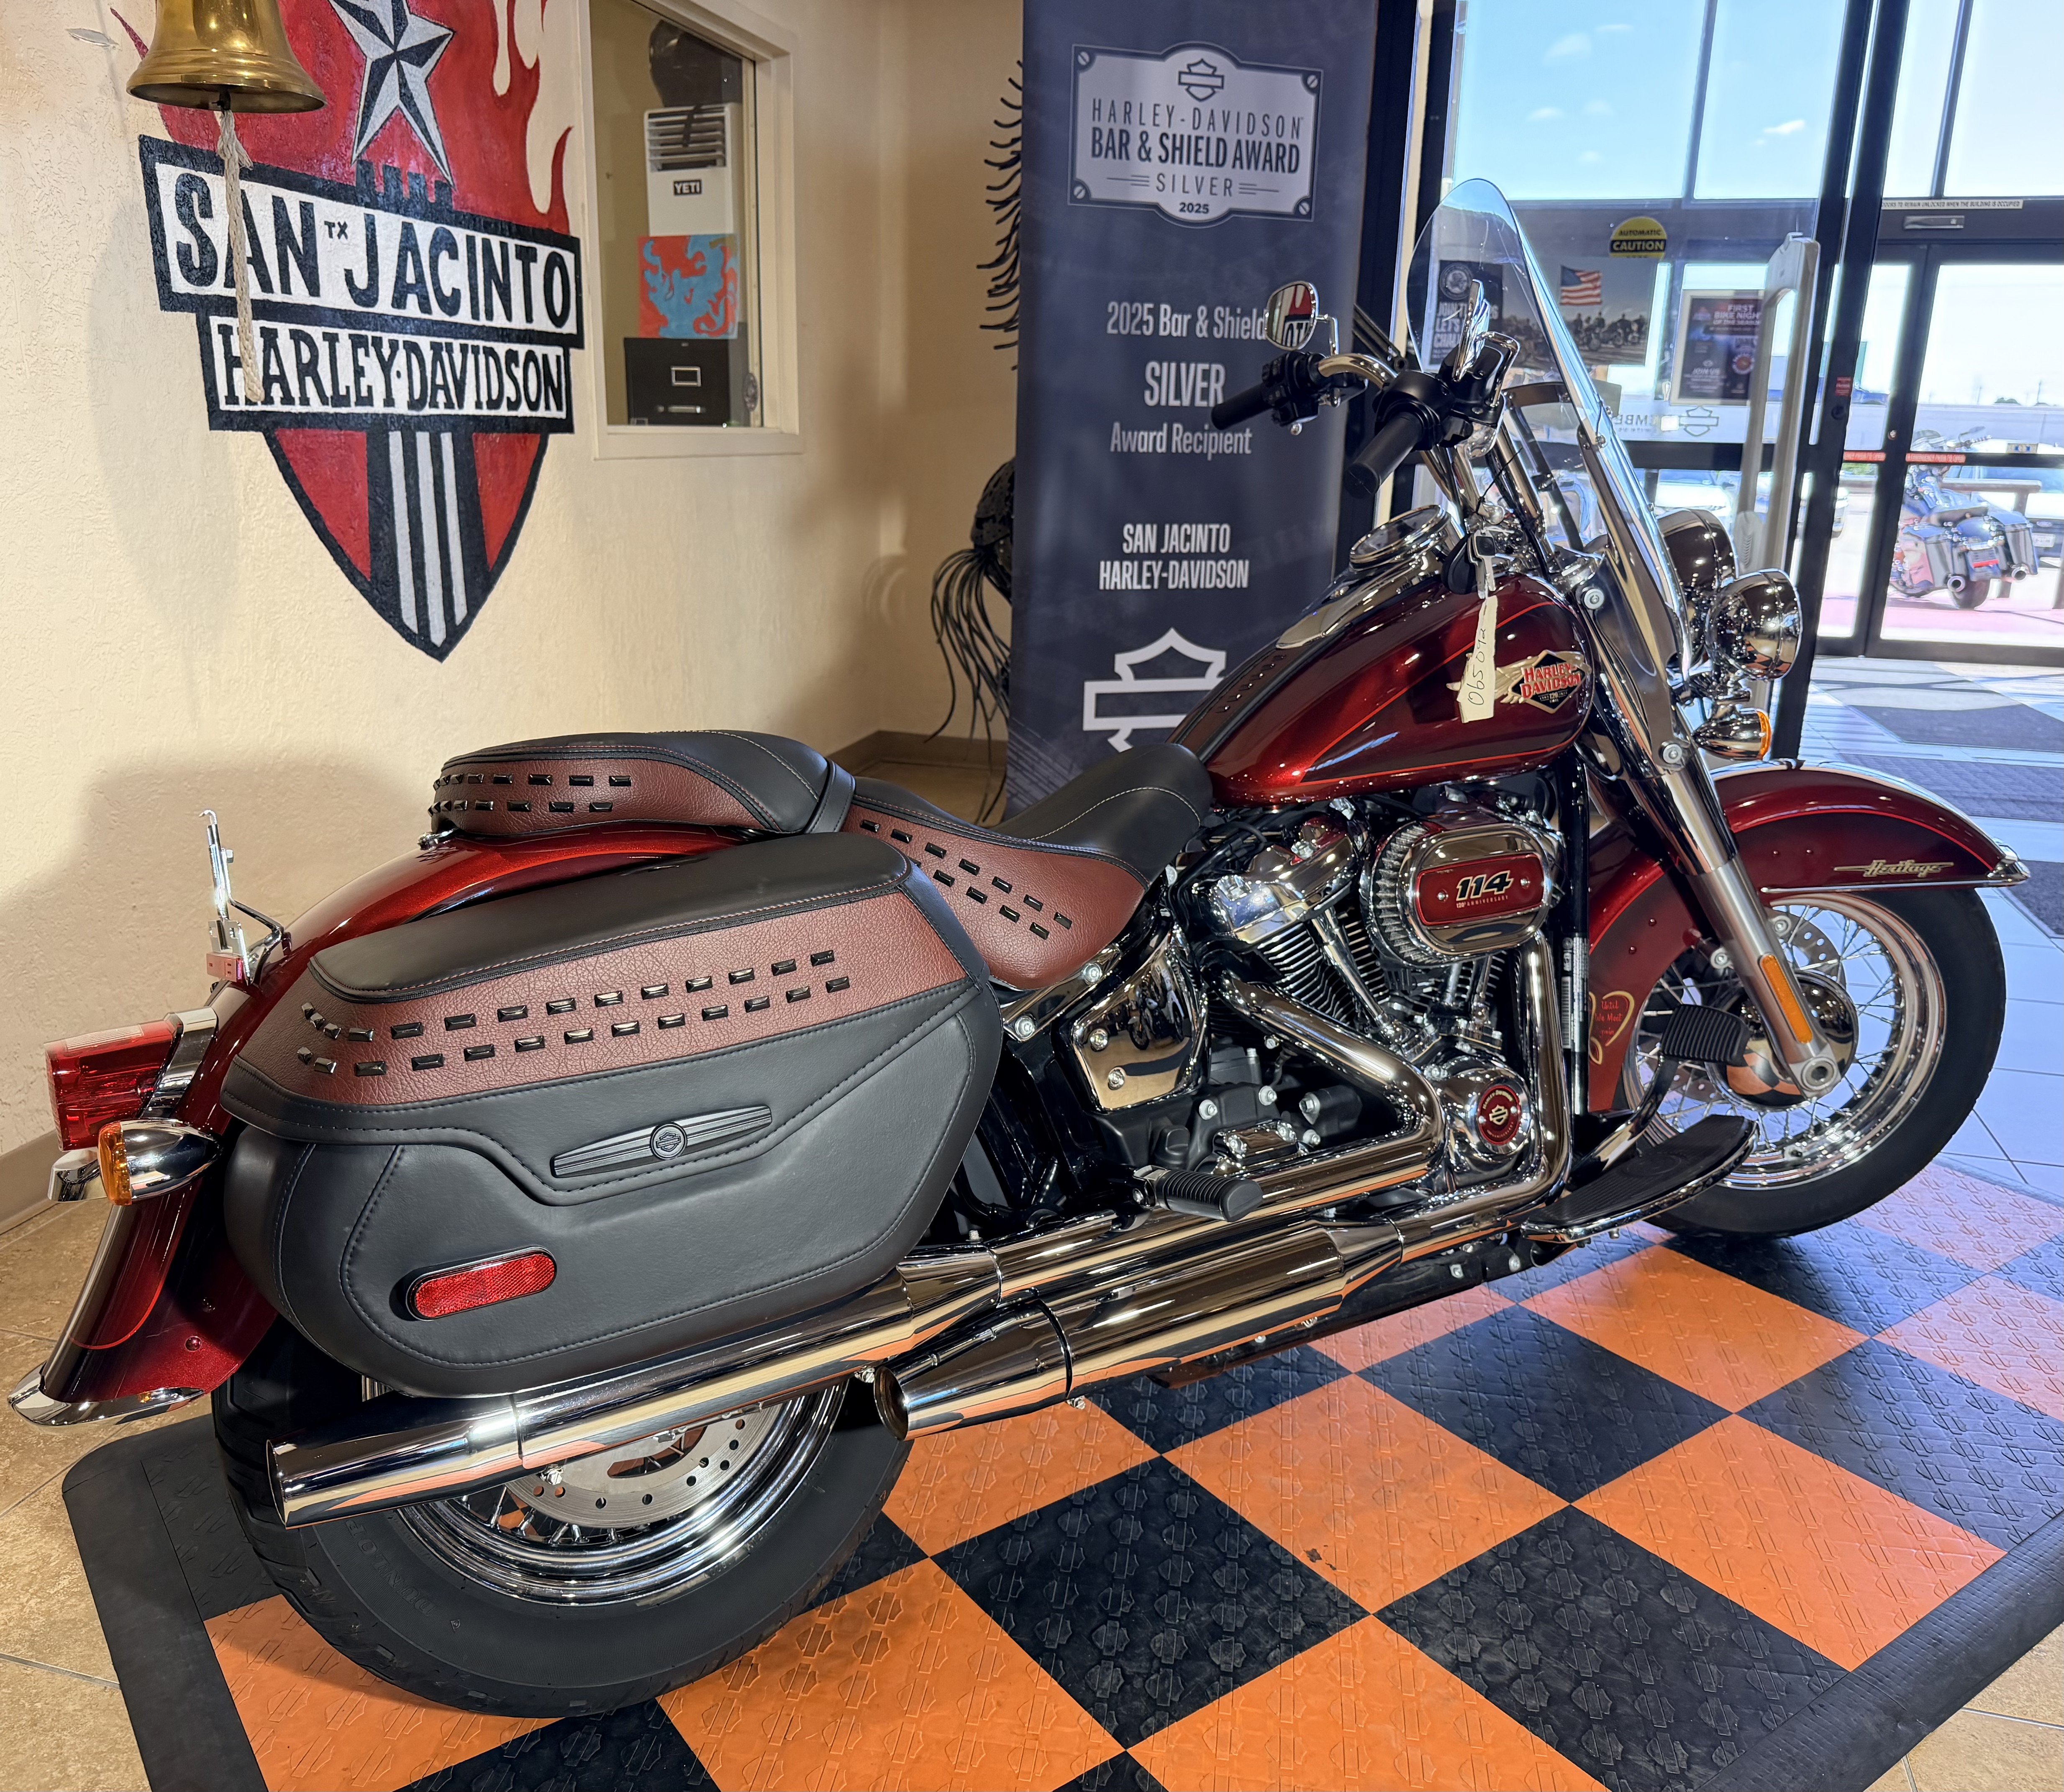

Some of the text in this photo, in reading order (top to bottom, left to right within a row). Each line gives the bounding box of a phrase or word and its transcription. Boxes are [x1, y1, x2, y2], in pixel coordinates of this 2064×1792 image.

[1091, 127, 1301, 174] BAR & SHIELD AWARD
[674, 181, 700, 194] YETI
[1156, 172, 1233, 197] SILVER
[1179, 202, 1210, 215] 2025
[175, 173, 572, 329] SAN TX JACINTO
[1613, 240, 1664, 251] CAUTION
[1107, 301, 1154, 336] 2025
[1159, 304, 1192, 338] Bar
[1195, 306, 1208, 338] &
[1213, 306, 1267, 340] Shield
[1144, 361, 1226, 408] SILVER
[1110, 423, 1252, 461] Award Recipient
[1122, 523, 1231, 554] SAN JACINTO
[1098, 559, 1250, 590] HARLEY-DAVIDSON
[1520, 673, 1581, 699] DAVIDSON
[1834, 859, 1954, 878] Heritage
[1456, 870, 1514, 901] 114
[1467, 895, 1508, 906] ANNIVERSARY
